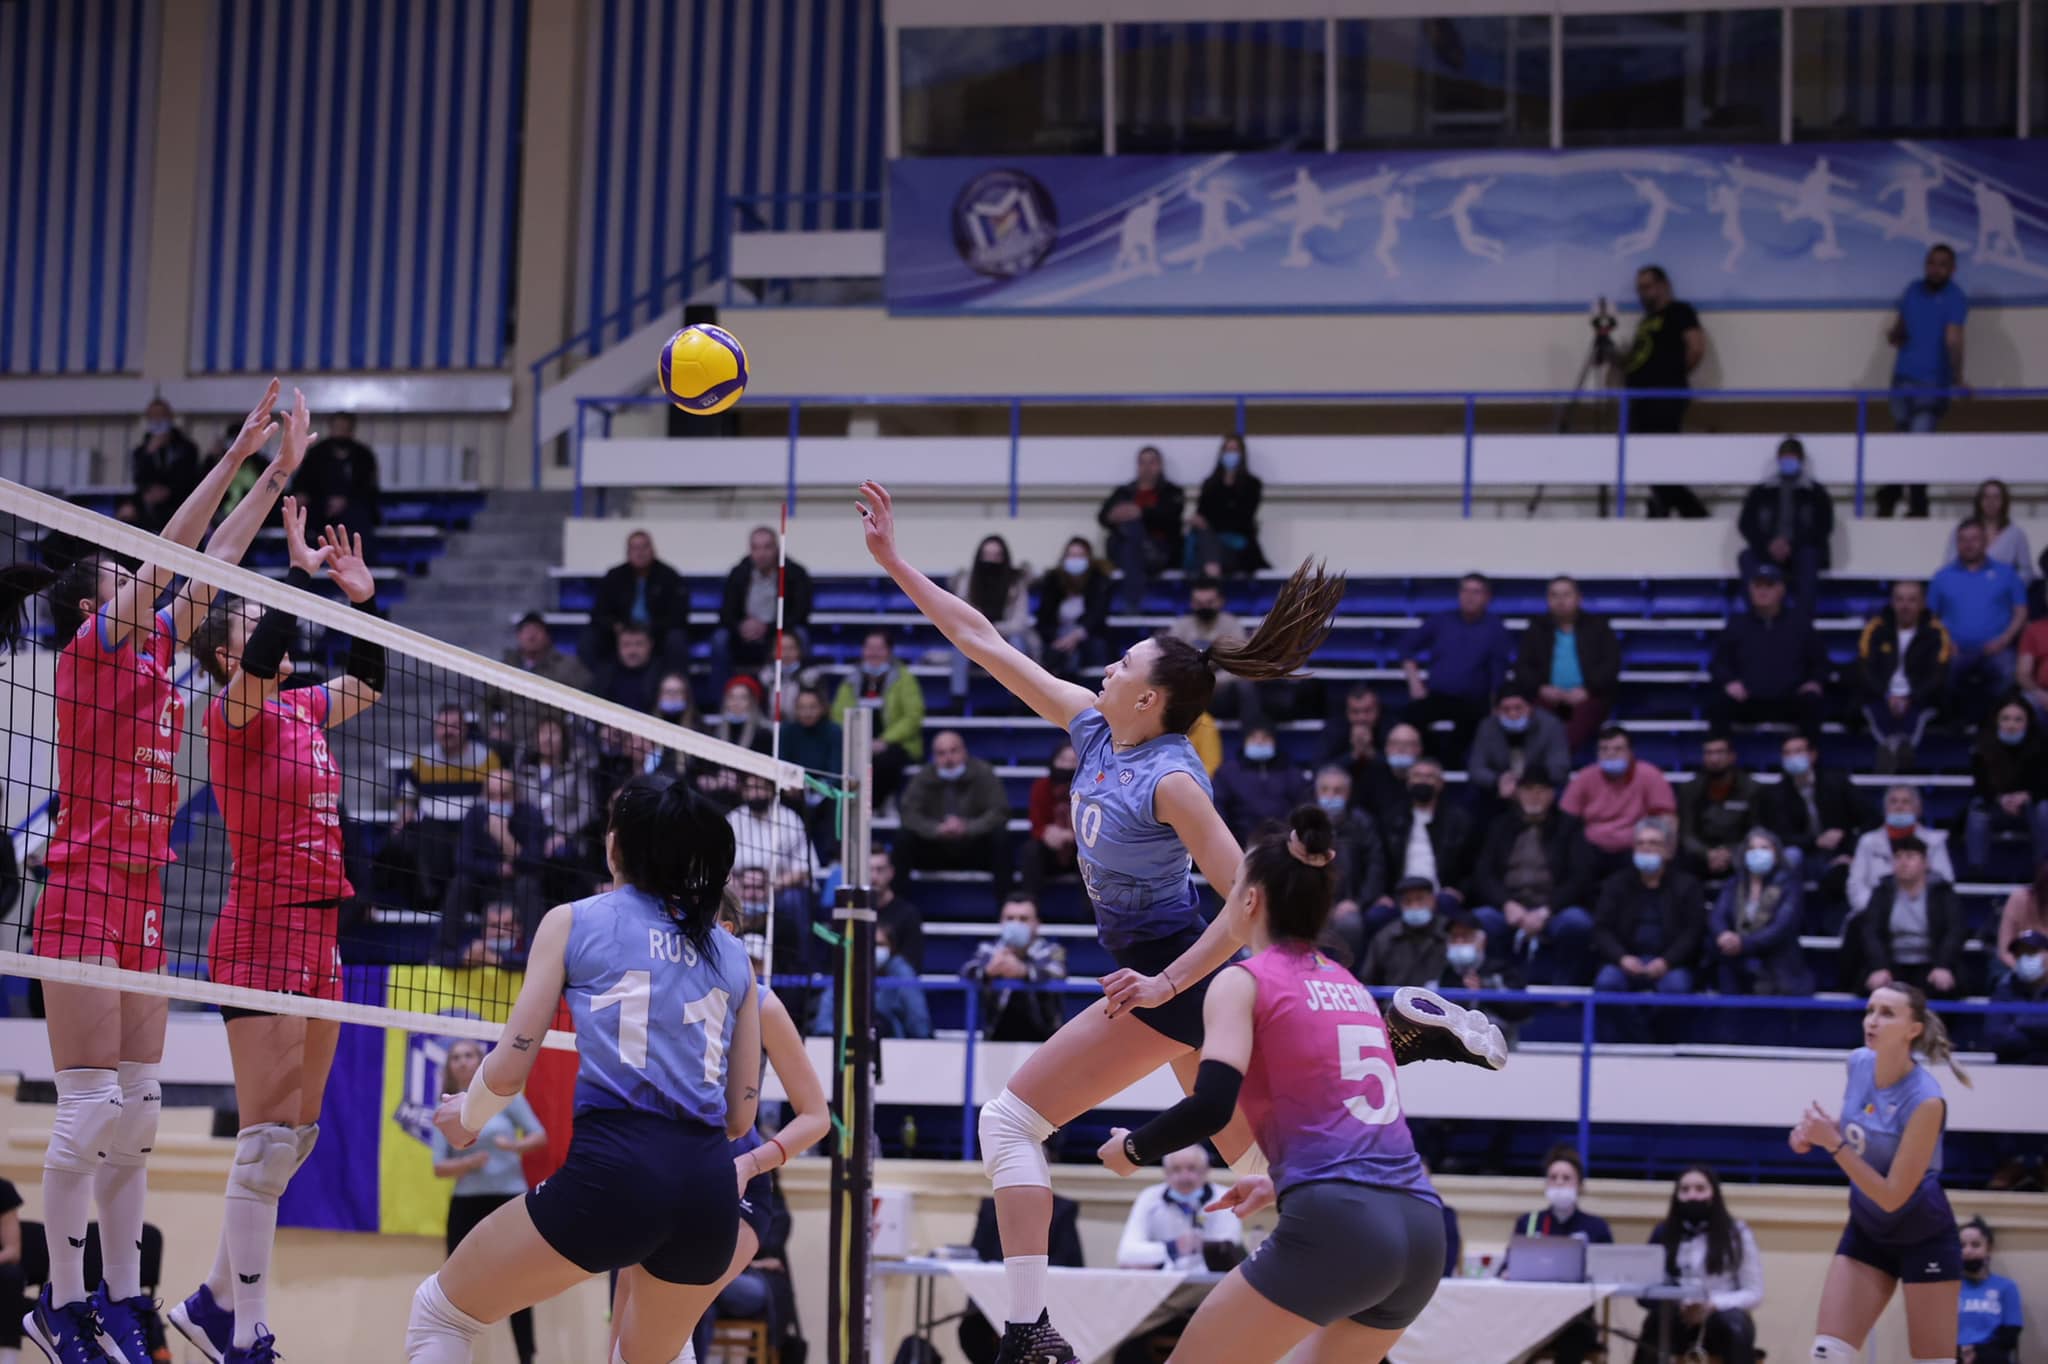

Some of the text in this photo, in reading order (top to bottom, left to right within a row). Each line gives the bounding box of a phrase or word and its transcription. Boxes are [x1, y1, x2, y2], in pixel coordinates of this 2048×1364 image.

[159, 695, 180, 738] 6
[1070, 790, 1103, 849] 10
[143, 909, 159, 947] 6
[648, 927, 699, 968] RUS
[590, 969, 730, 1086] 11
[1336, 1023, 1401, 1126] 5
[1845, 1122, 1867, 1156] 9
